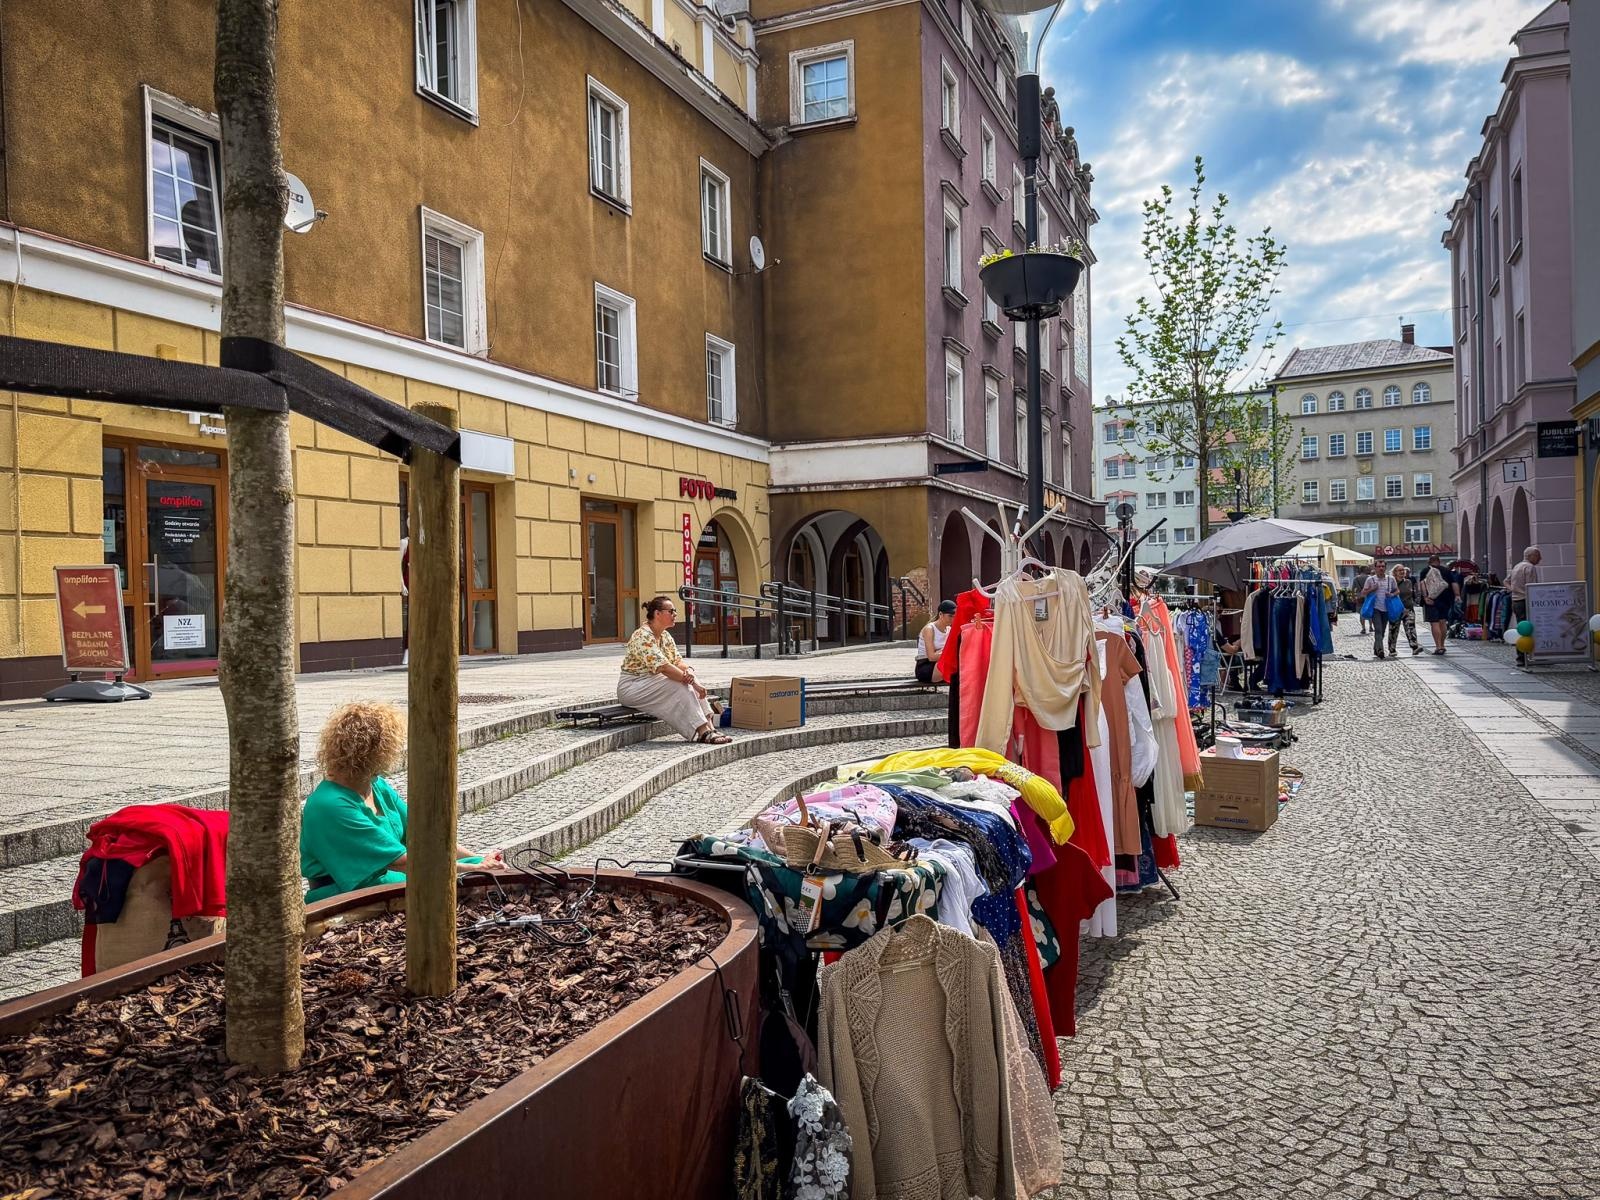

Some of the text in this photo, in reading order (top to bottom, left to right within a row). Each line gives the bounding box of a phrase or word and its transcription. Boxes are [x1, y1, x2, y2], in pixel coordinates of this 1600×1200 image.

[1541, 427, 1575, 436] JUBILER
[679, 477, 715, 500] FOTO
[160, 496, 202, 508] amplifon
[1375, 543, 1456, 556] ROSSMANN
[64, 574, 97, 585] amplifon
[1531, 599, 1584, 609] PROMOCJA
[72, 631, 113, 639] BEZPŁATNE
[79, 649, 109, 657] SŁUCHU
[769, 690, 799, 698] castorama
